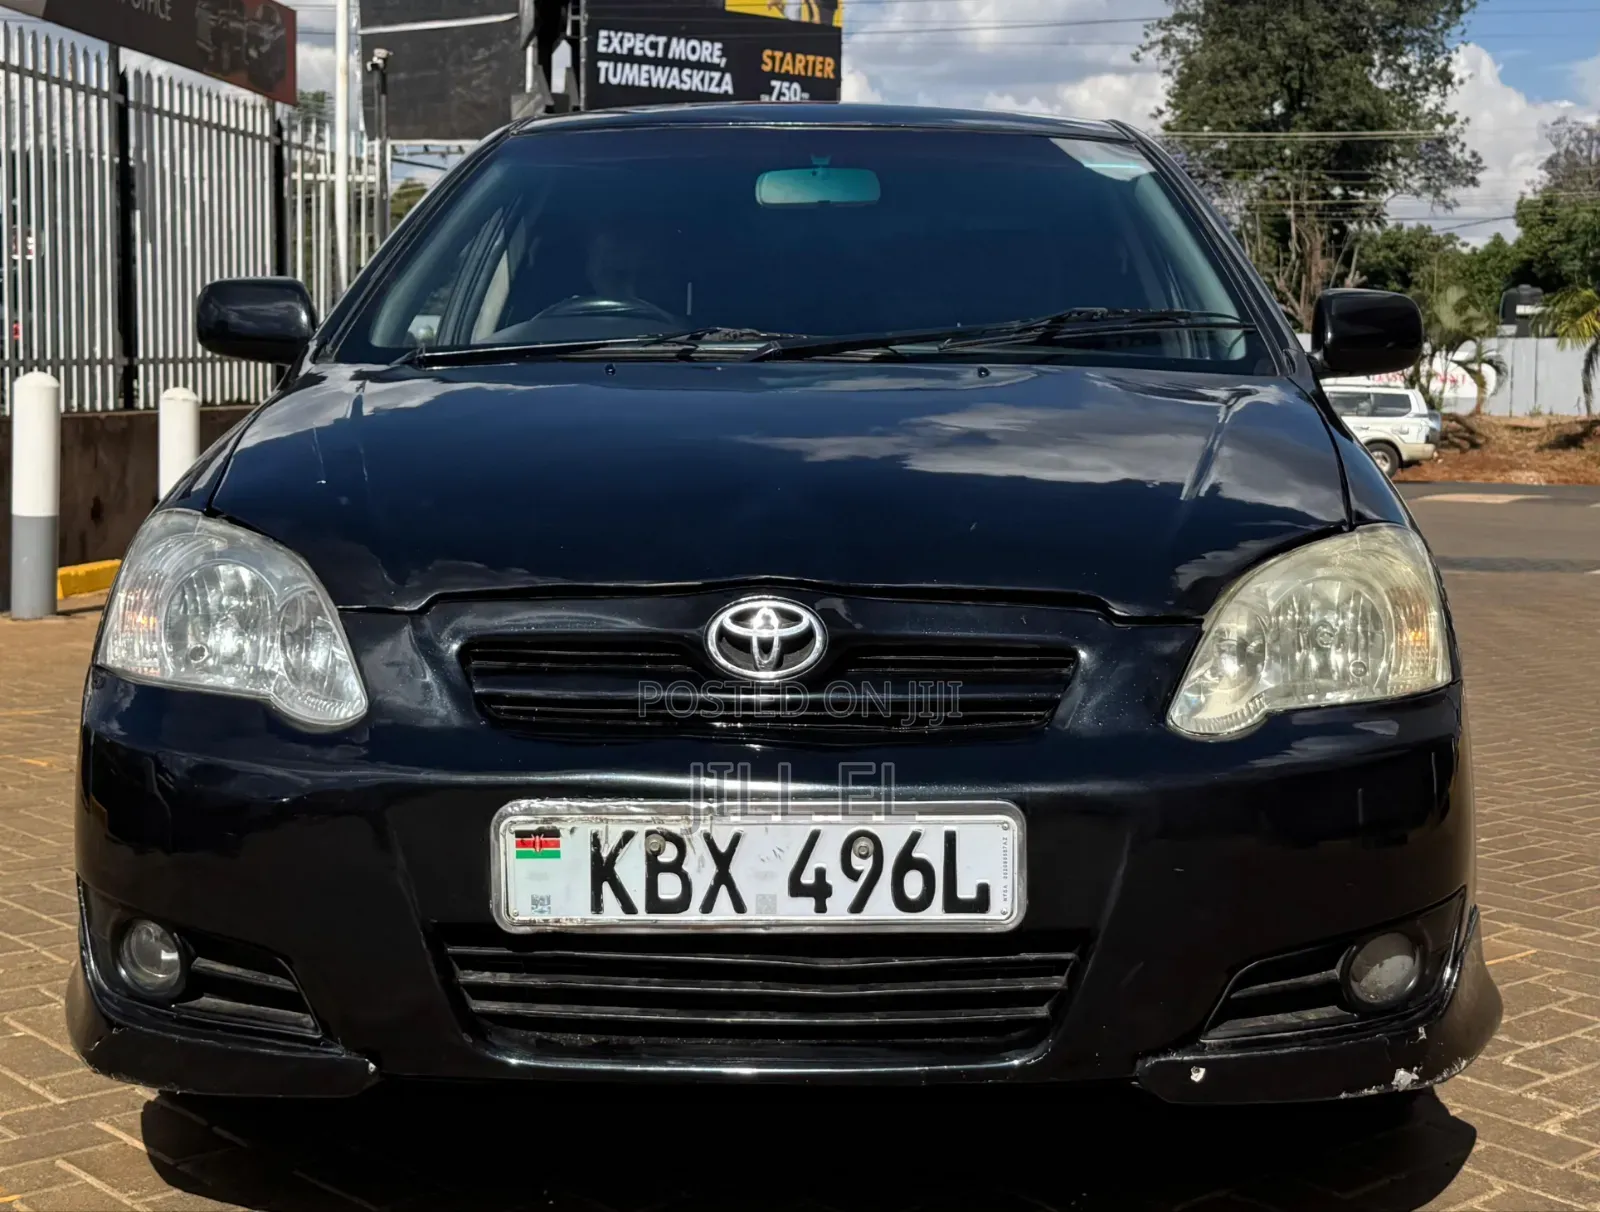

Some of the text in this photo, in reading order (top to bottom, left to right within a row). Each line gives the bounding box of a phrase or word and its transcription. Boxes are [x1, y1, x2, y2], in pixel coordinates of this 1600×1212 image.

[597, 30, 727, 68] EXPECT MORE,
[761, 49, 835, 79] STARTER
[597, 61, 734, 95] TUMEWASKIZA
[770, 80, 801, 101] 750
[590, 829, 748, 915] KBX
[787, 828, 991, 914] 496L
